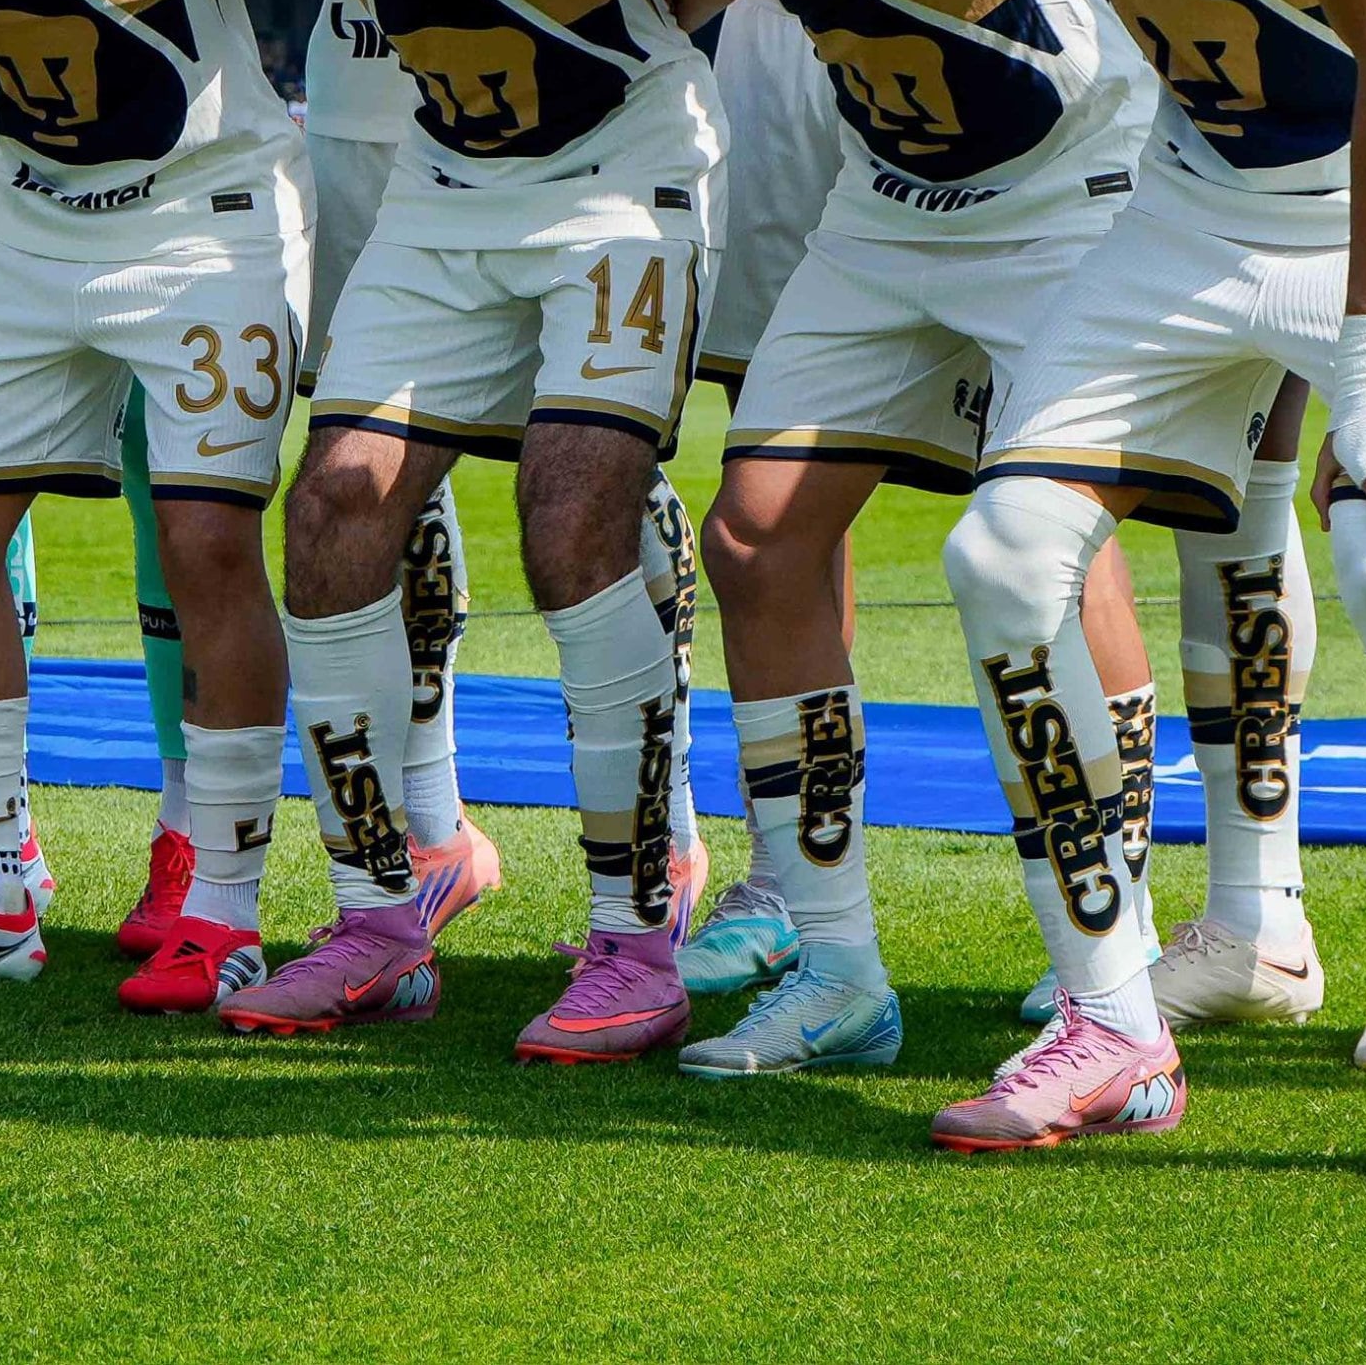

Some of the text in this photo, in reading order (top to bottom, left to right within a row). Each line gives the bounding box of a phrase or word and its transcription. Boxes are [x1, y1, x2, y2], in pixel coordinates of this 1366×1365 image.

[175, 323, 282, 421] 33
[586, 253, 667, 355] 14
[399, 497, 456, 725] CRES
[1216, 554, 1294, 822] CREST
[797, 691, 854, 868] CRE
[979, 647, 1122, 938] CREST
